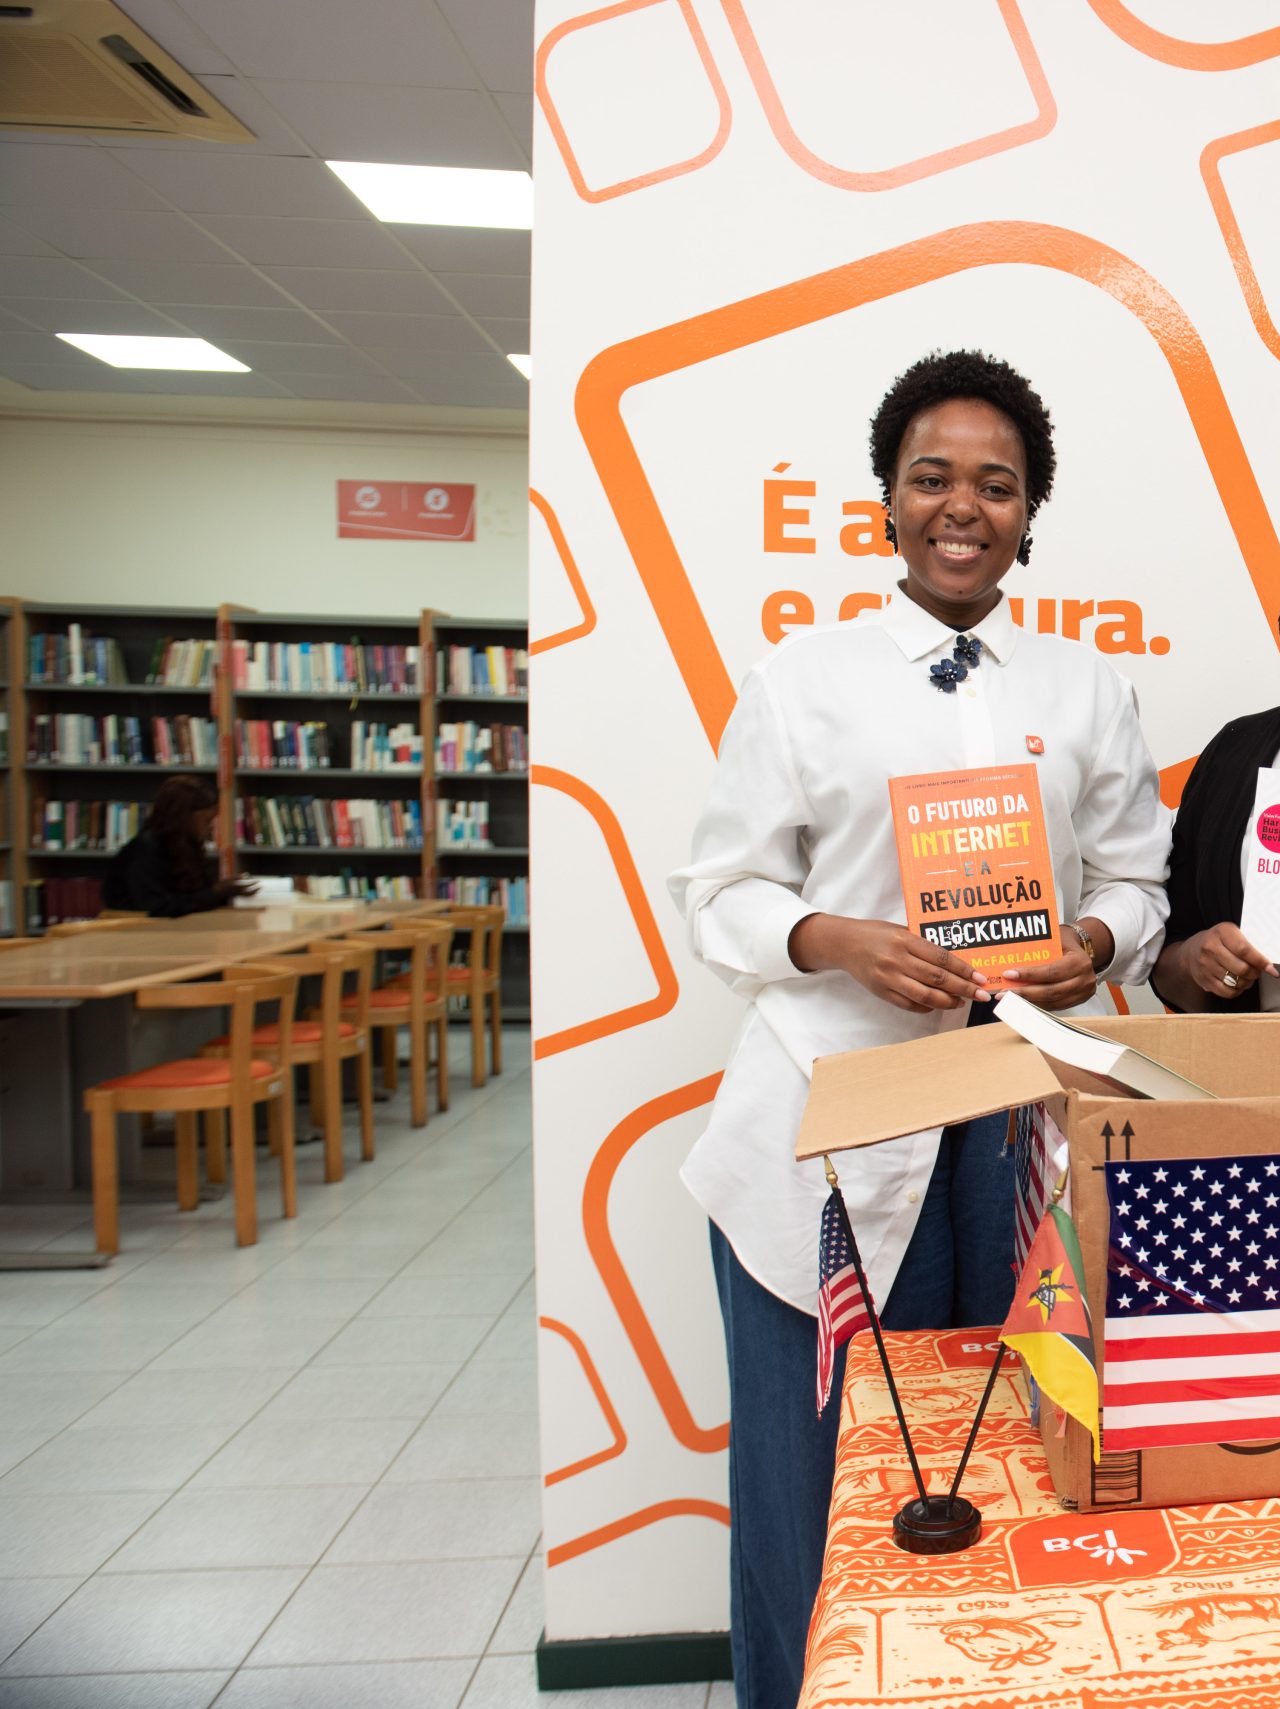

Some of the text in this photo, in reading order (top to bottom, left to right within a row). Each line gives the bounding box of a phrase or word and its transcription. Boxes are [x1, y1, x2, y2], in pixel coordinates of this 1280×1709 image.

[764, 462, 816, 554] É
[761, 590, 815, 645] e
[908, 793, 1029, 824] O FUTURO DA
[911, 820, 1032, 858] INTERNET
[964, 860, 992, 877] E A
[920, 876, 1042, 913] REVOLUÇÃO
[924, 914, 1048, 948] BLOCKCHAIN
[971, 949, 1051, 969] McFARLAND
[1043, 1529, 1118, 1554] BCI
